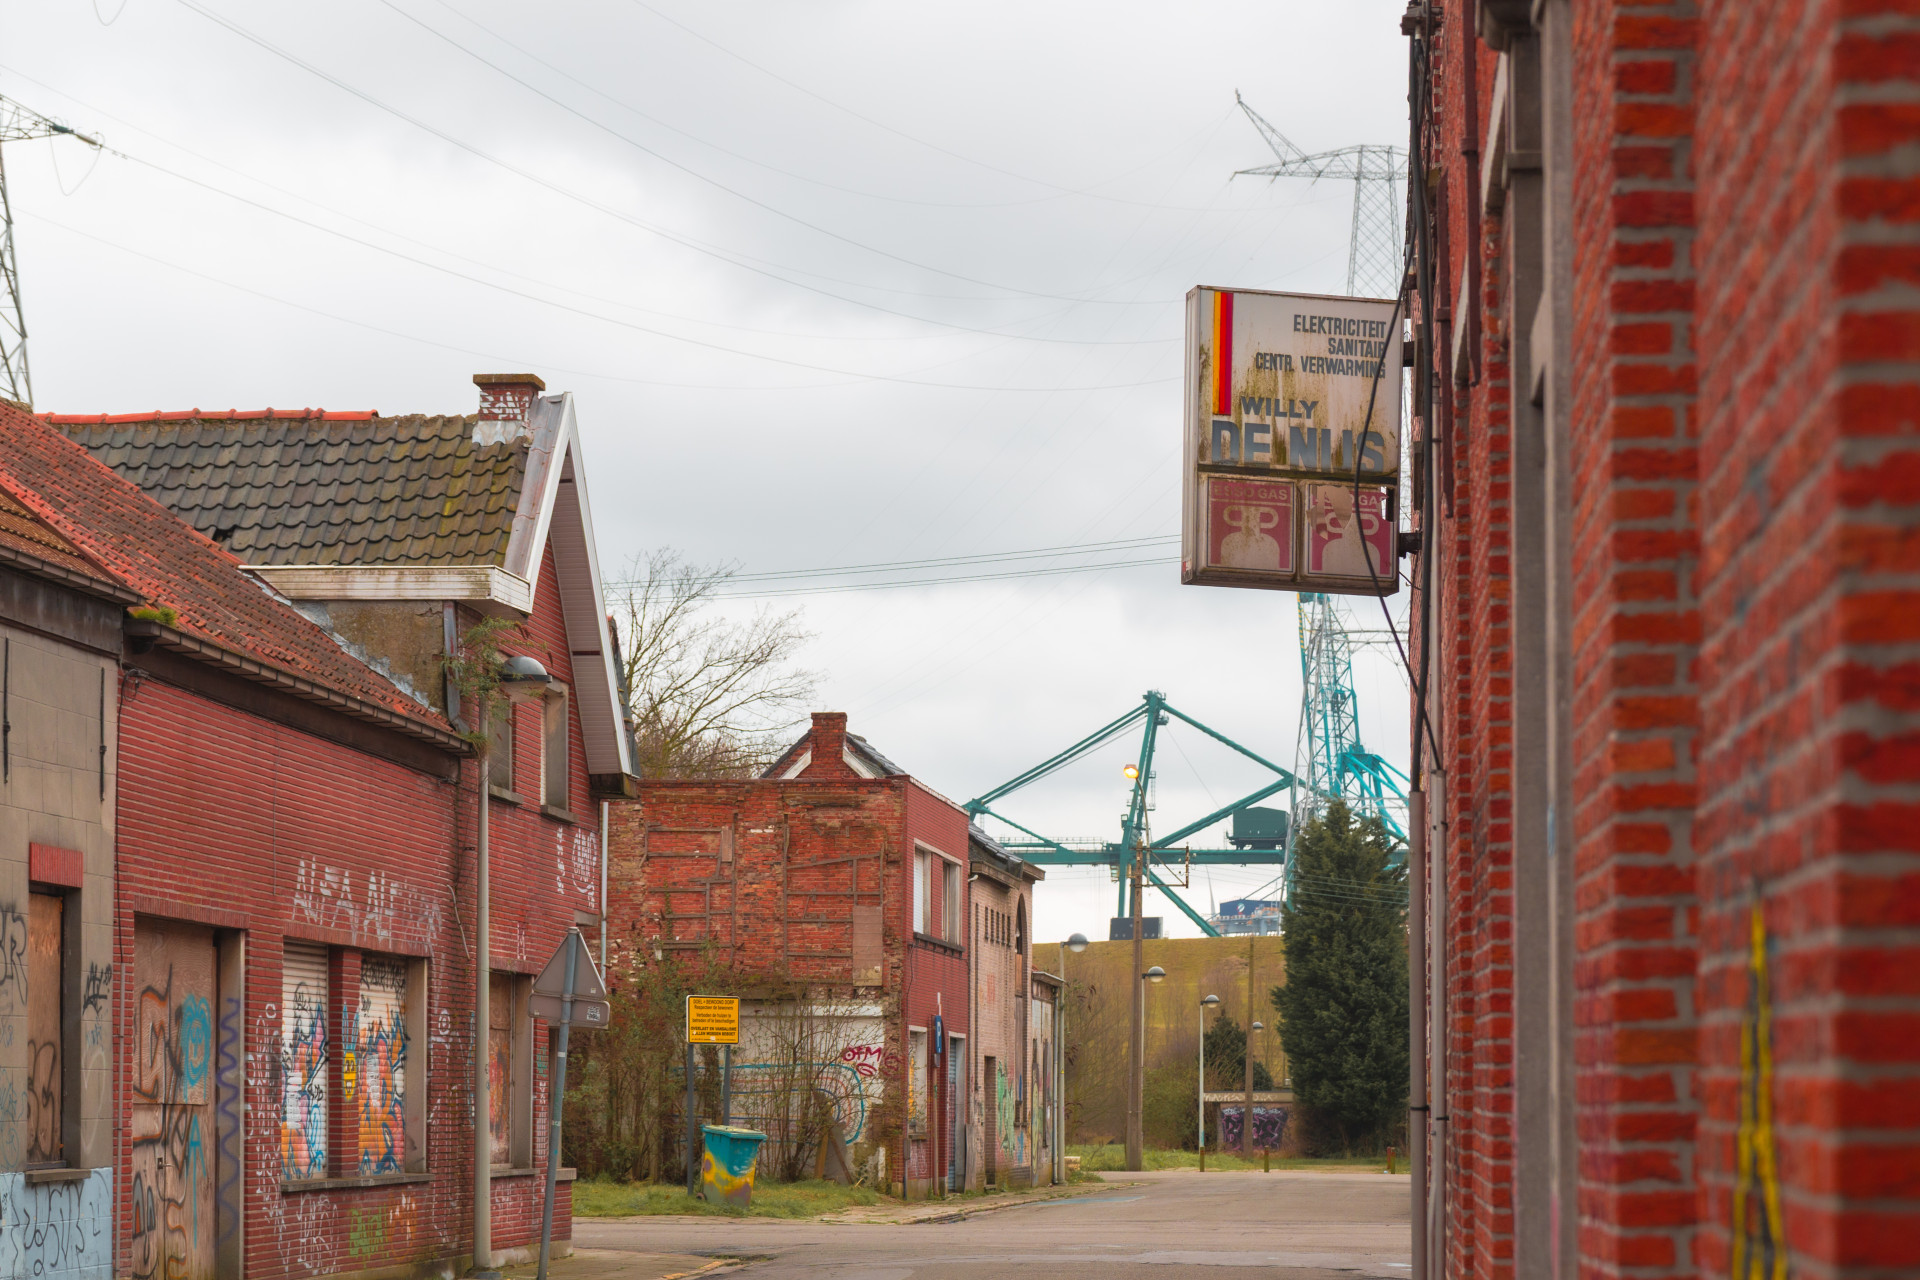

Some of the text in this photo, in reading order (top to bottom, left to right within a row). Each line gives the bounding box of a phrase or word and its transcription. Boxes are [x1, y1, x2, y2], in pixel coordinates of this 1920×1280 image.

[1293, 314, 1387, 338] ELEKTRICITEIT
[1327, 337, 1386, 359] SANITAIR
[1255, 352, 1386, 379] CENTR. VERWARMING
[1240, 396, 1319, 420] WILLY
[1211, 419, 1271, 466] DE
[1213, 484, 1289, 501] ESSO GAS
